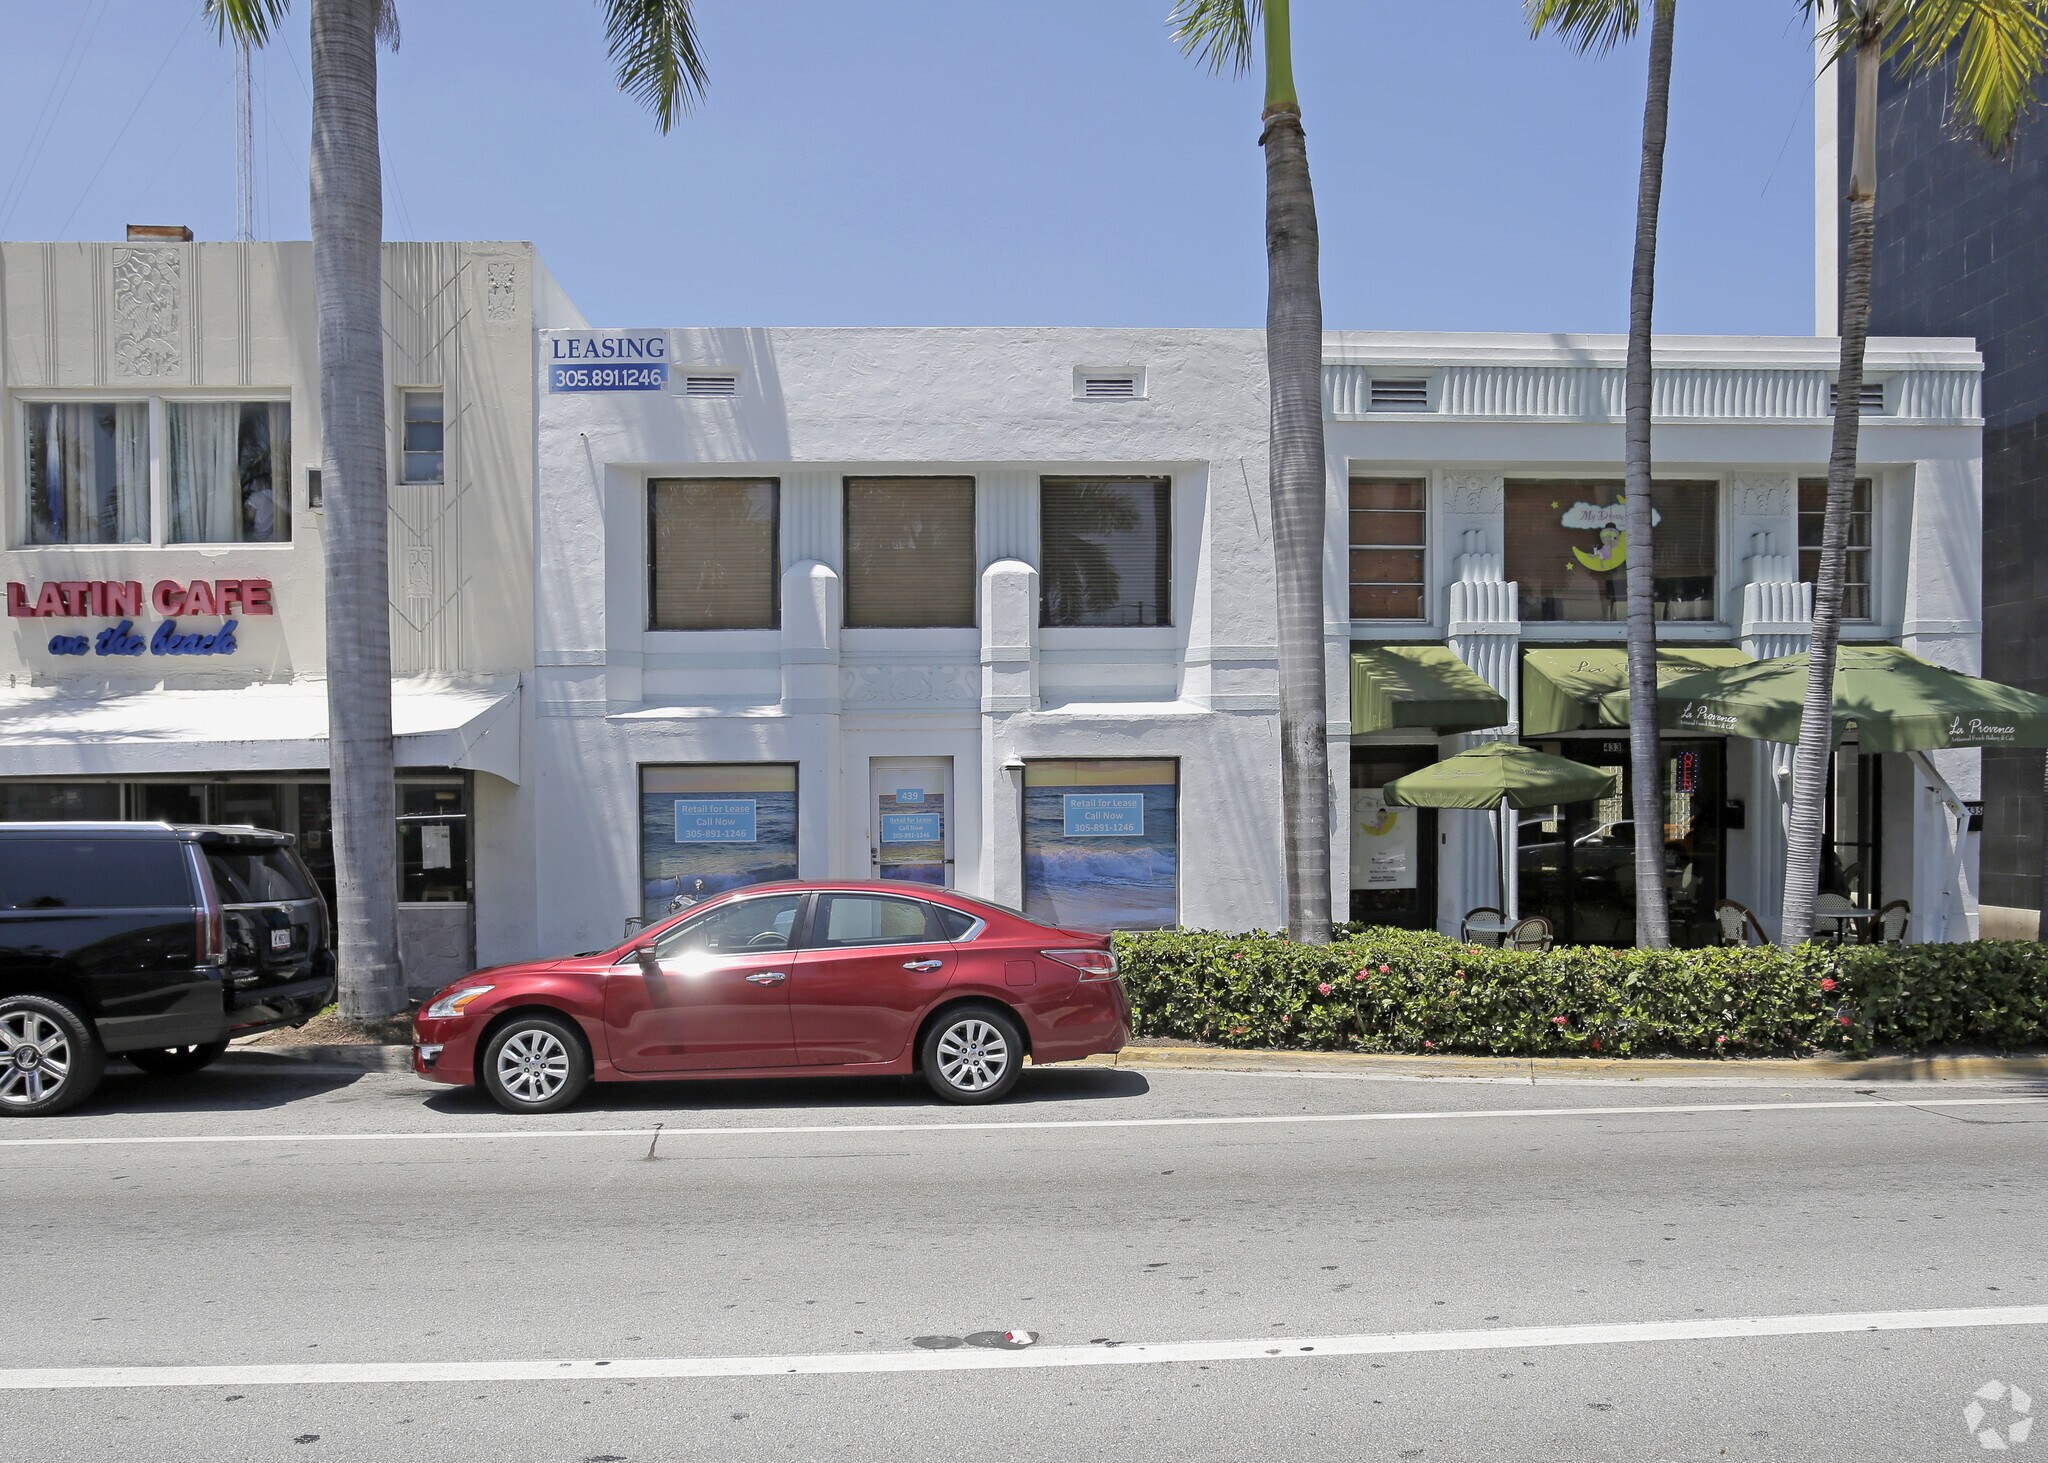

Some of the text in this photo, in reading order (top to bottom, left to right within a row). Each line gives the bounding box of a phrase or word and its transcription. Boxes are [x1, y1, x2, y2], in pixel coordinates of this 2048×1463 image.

[551, 338, 665, 359] LEASING
[555, 369, 662, 387] 305.891.1246
[1579, 510, 1596, 521] My
[6, 579, 273, 617] LATIN CAFE
[48, 619, 239, 656] on the beach
[1570, 660, 1606, 674] La
[1681, 701, 1738, 723] La Provence
[1949, 715, 2016, 735] La Provence
[1683, 753, 1693, 791] OPEN
[901, 791, 919, 801] 439
[1070, 798, 1137, 808] Retail for Lease
[681, 804, 750, 814] Retail for Lease
[1085, 811, 1124, 820] Call Now
[696, 817, 736, 827] Call Now
[1074, 823, 1134, 832] 305-891-1246
[686, 829, 747, 838] 305-891-1246
[898, 824, 910, 832] Call
